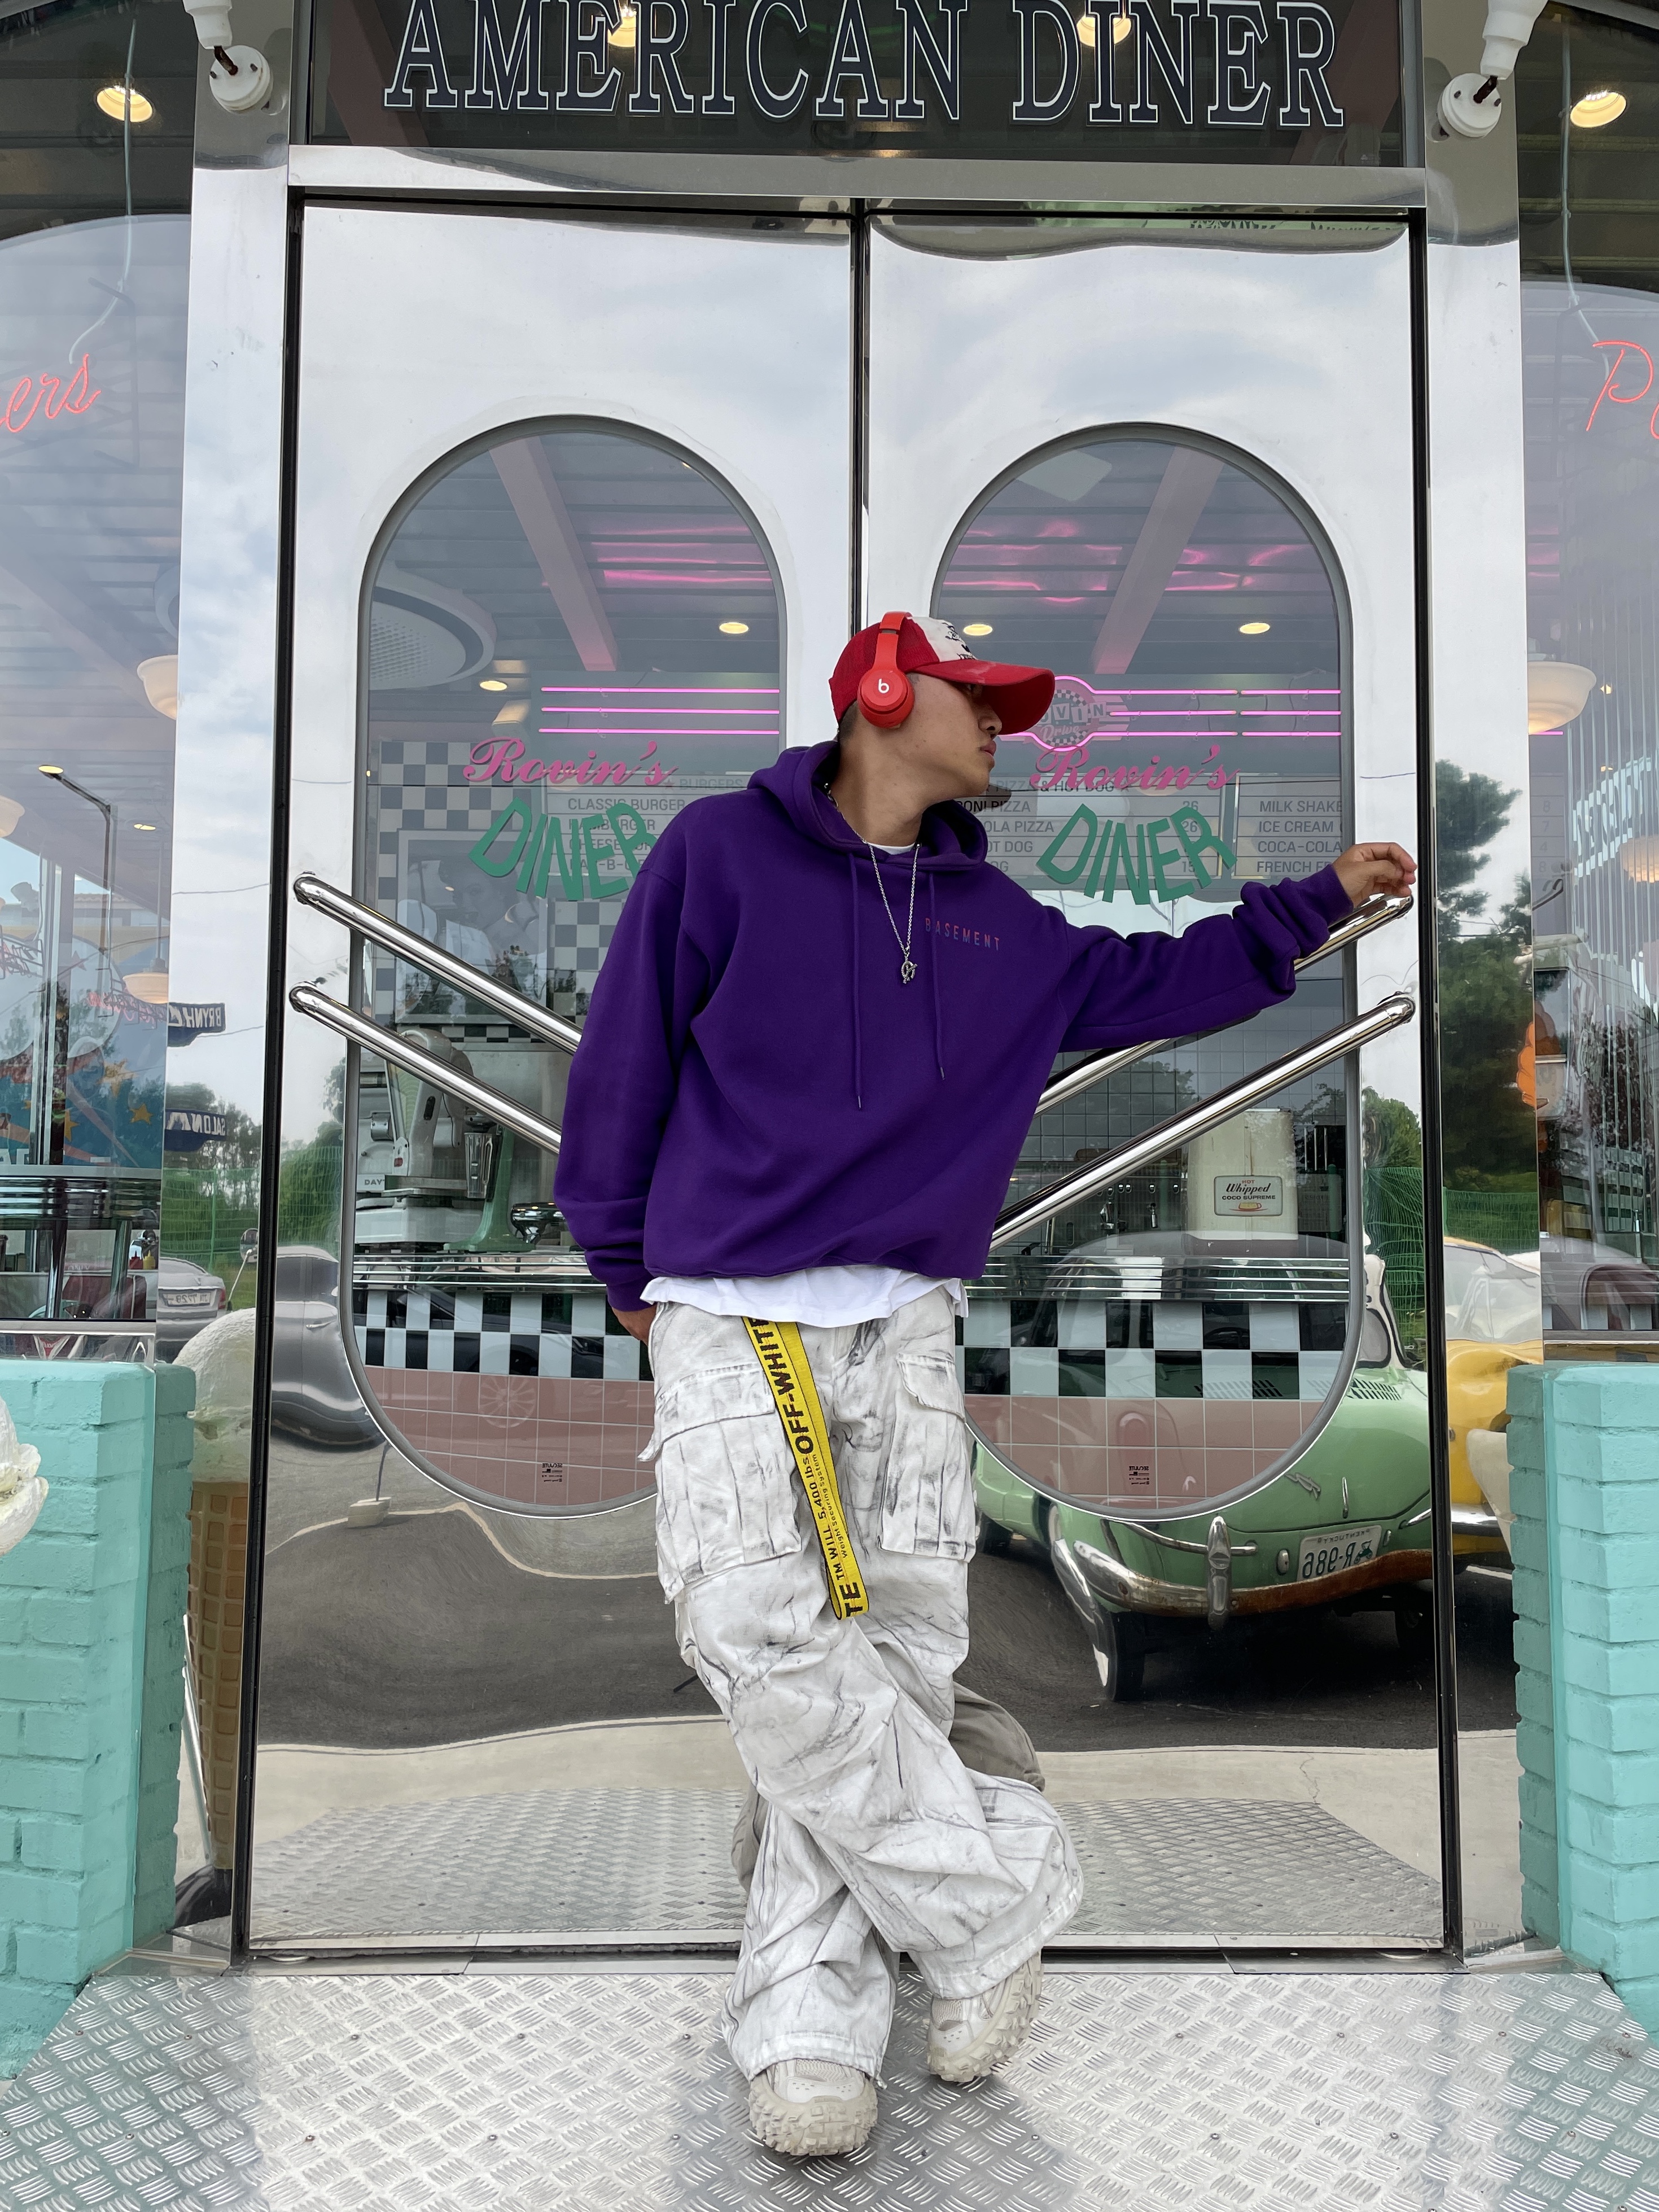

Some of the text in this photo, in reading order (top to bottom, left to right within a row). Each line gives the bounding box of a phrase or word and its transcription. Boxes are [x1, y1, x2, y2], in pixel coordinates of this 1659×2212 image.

[384, 0, 1344, 127] AMERICAN DINER
[0, 353, 102, 433] ers
[462, 737, 679, 786] Rovin's
[1029, 744, 1240, 791] Rovin's
[631, 798, 686, 811] BURGER
[991, 800, 1031, 812] PIZZA
[1259, 800, 1293, 812] MILK
[1014, 820, 1054, 833] PIZZA
[1259, 820, 1281, 833] ICE
[1284, 820, 1334, 833] CREAM
[468, 796, 659, 902] DINER
[1004, 841, 1033, 853] DOG
[1036, 803, 1237, 904] DINER
[1258, 841, 1343, 853] COCA-COLA
[1257, 861, 1311, 873] FRENCH
[925, 917, 1000, 951] BASEMENT
[1225, 1183, 1272, 1195] Whipped
[802, 1457, 815, 1479] lbs
[809, 1483, 827, 1520] 5,400
[812, 1454, 848, 1559] Weight Securing System
[822, 1524, 839, 1560] WILL
